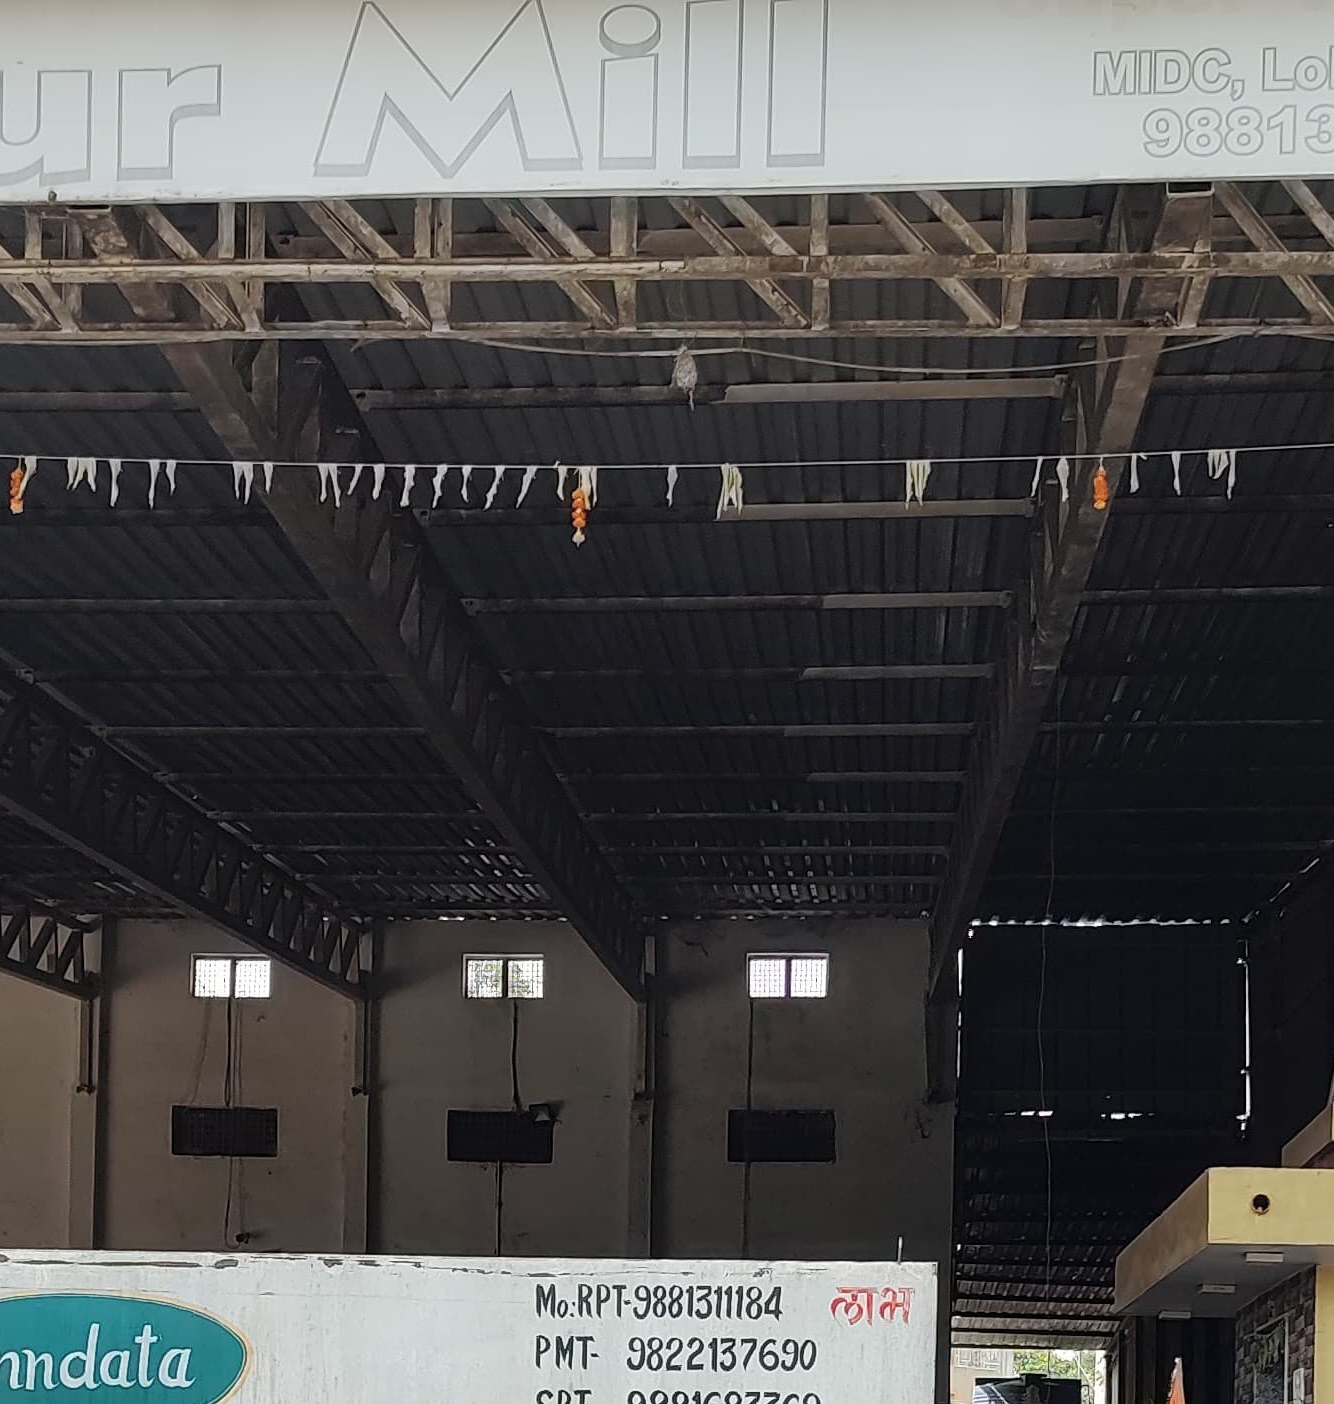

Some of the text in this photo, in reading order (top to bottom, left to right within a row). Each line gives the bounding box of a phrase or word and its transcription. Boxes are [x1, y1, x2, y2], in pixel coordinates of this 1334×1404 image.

[312, 0, 829, 180] Mill
[1092, 47, 1245, 101] MIDC,
[829, 1286, 915, 1328] लाभ
[535, 1335, 818, 1373] PMT- 9822137690
